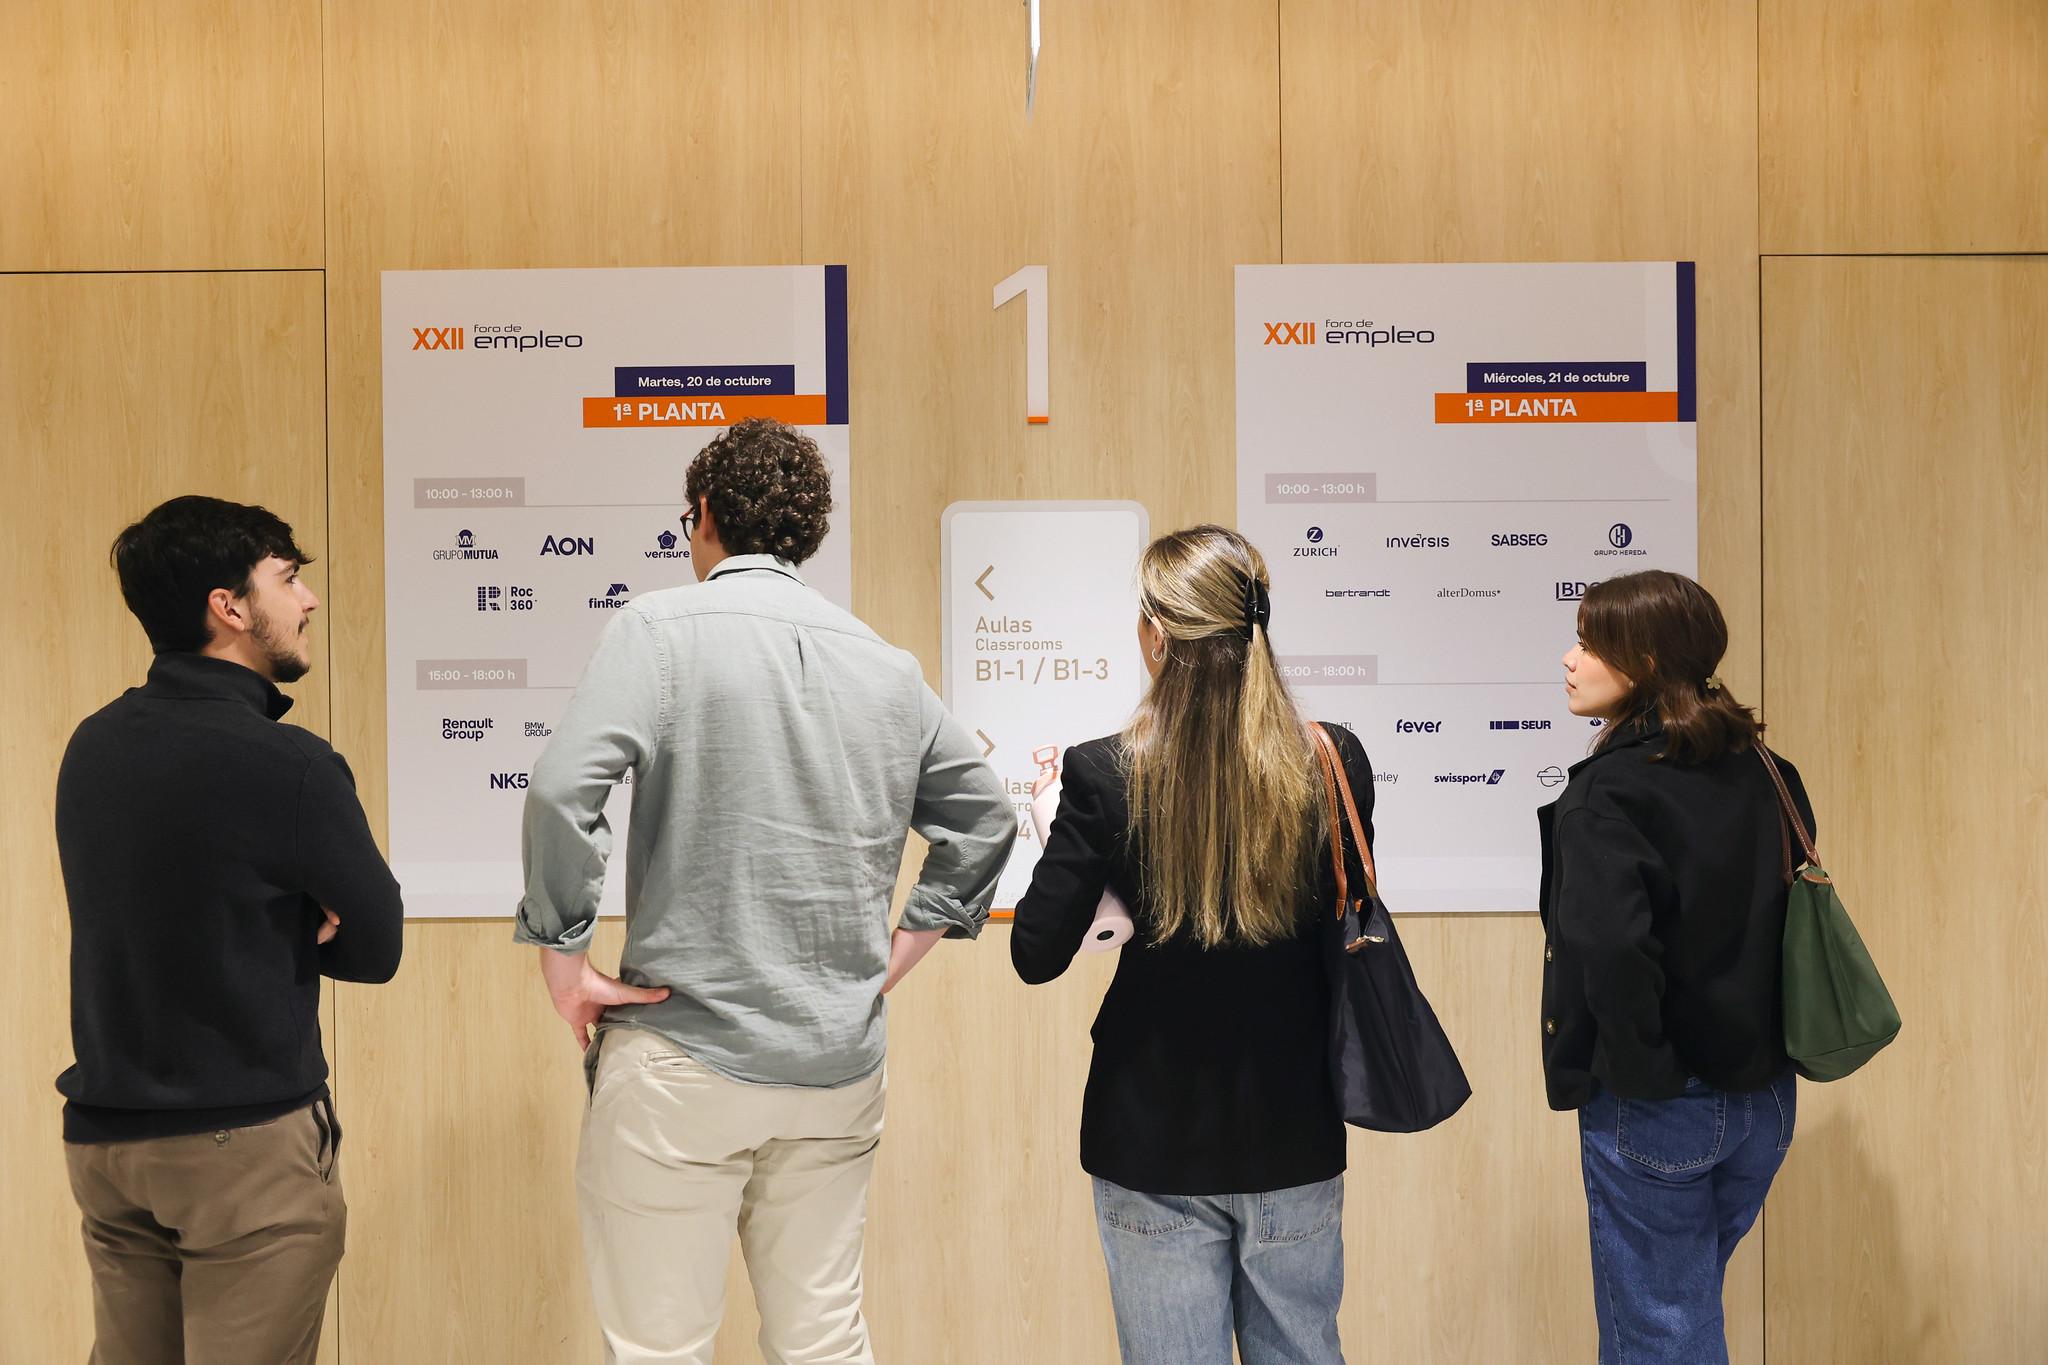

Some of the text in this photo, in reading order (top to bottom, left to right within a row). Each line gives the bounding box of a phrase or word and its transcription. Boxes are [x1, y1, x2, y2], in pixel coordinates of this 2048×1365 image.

[474, 324, 522, 333] foro de
[1325, 319, 1374, 328] foro de
[412, 327, 583, 353] XXII empleo
[1263, 322, 1435, 348] XXII empleo
[993, 265, 1049, 424] 1
[638, 375, 772, 389] Martes, 20 de octubre
[1483, 372, 1630, 385] Miércoles, 21 de octubre
[612, 402, 726, 421] 1ª PLANTA
[1464, 398, 1577, 417] 1ª PLANTA
[425, 488, 459, 499] 10:00
[470, 487, 503, 499] 13:00
[505, 487, 513, 499] h
[1276, 483, 1310, 495] 10:00
[1321, 483, 1354, 495] 13:00
[1356, 483, 1365, 494] h
[540, 535, 594, 556] AON
[1386, 534, 1450, 548] inversis
[1491, 533, 1548, 547] SABSEG
[644, 550, 690, 559] verisure
[1293, 547, 1338, 557] ZURICH
[510, 586, 534, 597] Roc
[1325, 588, 1391, 598] bertrandt
[510, 599, 534, 611] 360
[975, 615, 1033, 634] Aulas
[975, 638, 1063, 651] Classrooms
[472, 669, 505, 681] 18:00
[507, 669, 515, 680] h
[976, 656, 1109, 685] B1-1 / B1-3
[1280, 665, 1311, 677] 5:00
[1323, 665, 1355, 677] 18:00
[1358, 665, 1366, 676] h
[442, 717, 494, 729] Renault
[524, 721, 545, 730] BMW
[1396, 719, 1442, 734] fever
[1521, 720, 1551, 730] SEUR
[442, 729, 484, 742] Group
[524, 729, 552, 737] GROUP
[1372, 771, 1399, 785] anley
[1434, 772, 1487, 785] swissport
[1004, 777, 1033, 795] las
